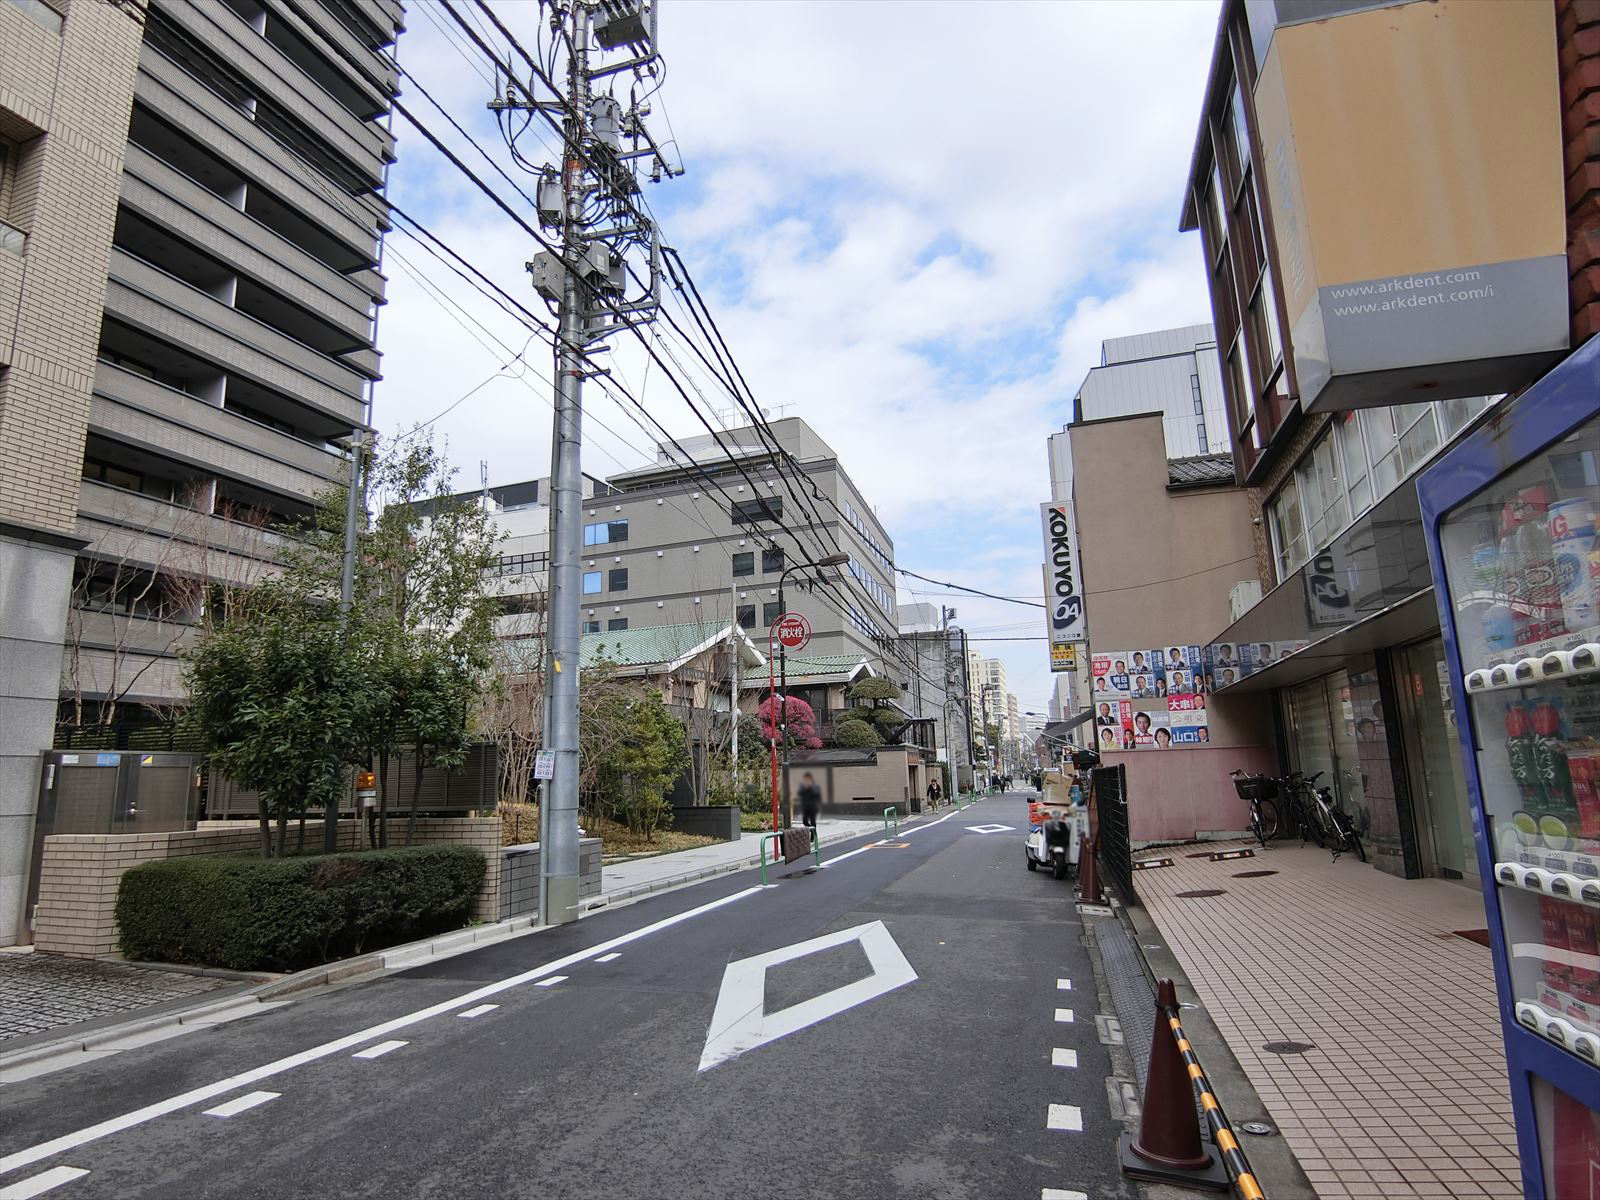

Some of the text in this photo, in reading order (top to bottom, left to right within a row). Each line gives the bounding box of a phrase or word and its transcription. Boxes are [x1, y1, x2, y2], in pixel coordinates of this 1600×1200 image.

[1331, 271, 1480, 299] www.arkdent.com
[1334, 284, 1494, 317] www.arkdent.com/i
[1049, 507, 1073, 597] KOKUYO
[1053, 603, 1079, 620] OA
[779, 626, 803, 639] 消火栓
[1173, 730, 1194, 743] 山口
